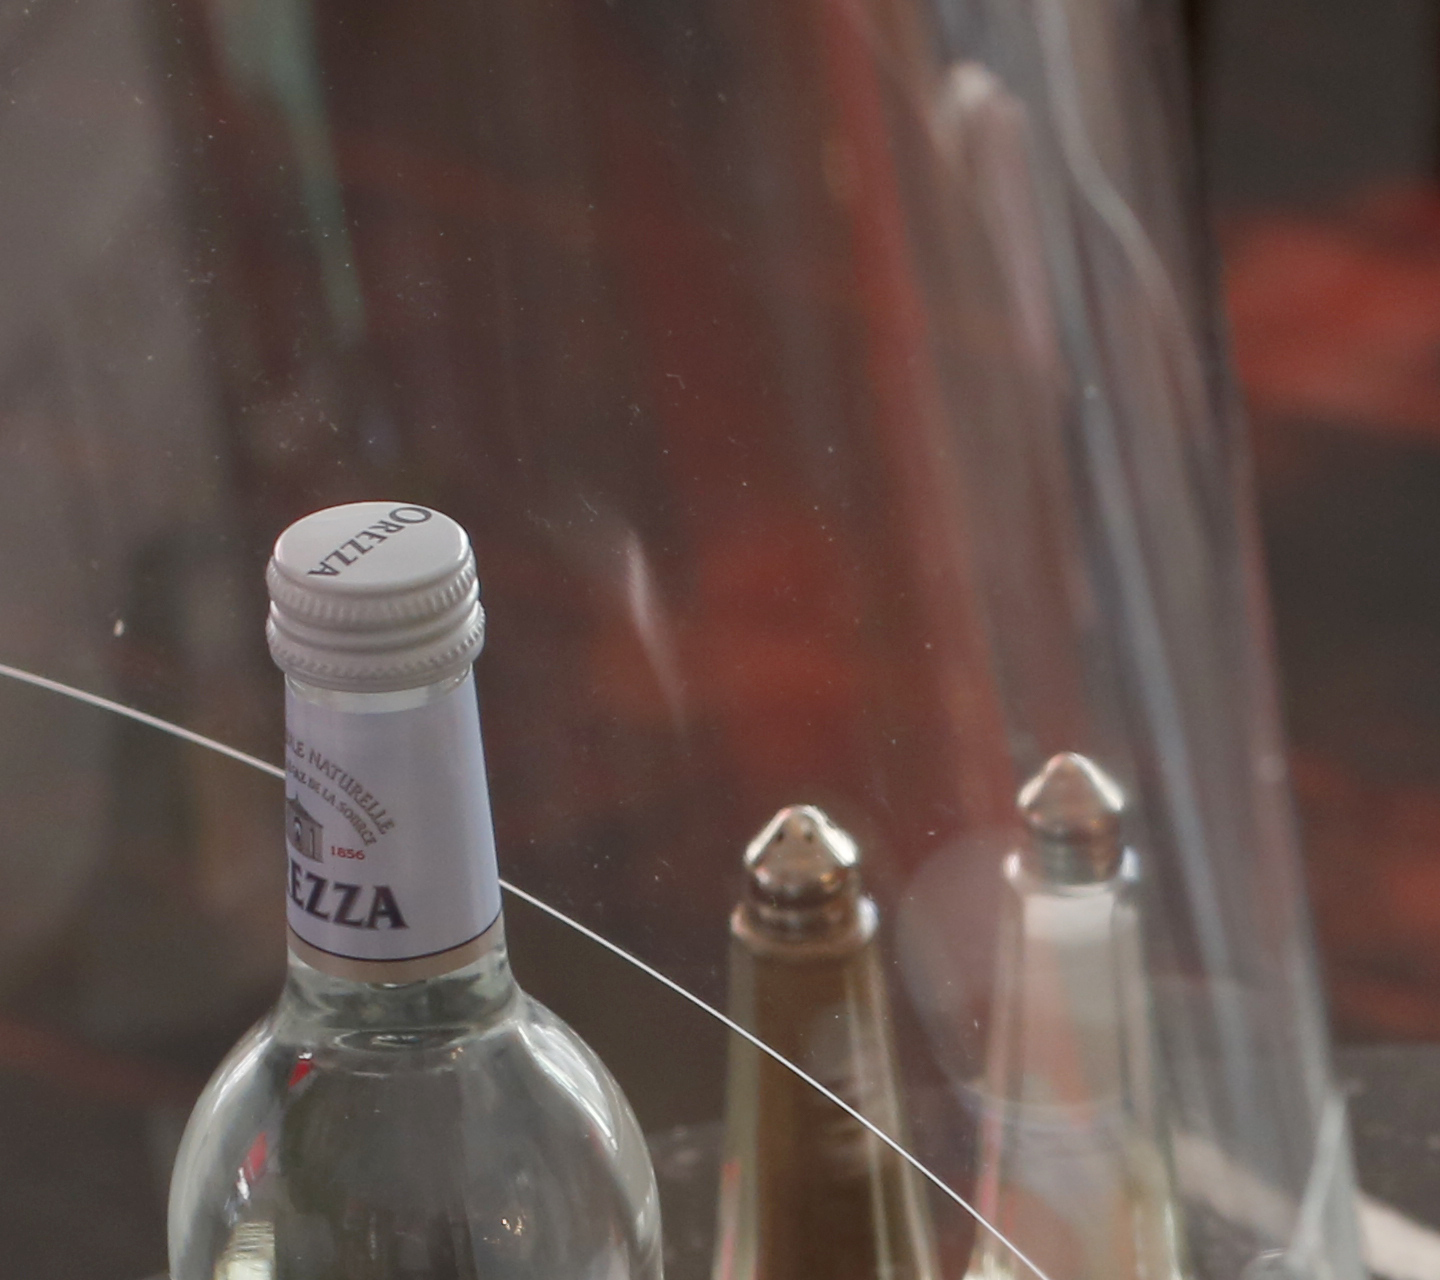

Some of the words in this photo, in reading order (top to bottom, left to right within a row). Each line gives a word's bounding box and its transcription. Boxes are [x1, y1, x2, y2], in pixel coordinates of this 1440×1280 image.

[307, 506, 432, 577] OREZZA
[309, 747, 394, 835] NATURELLE
[331, 846, 365, 860] 1856
[287, 857, 409, 930] EZZA
